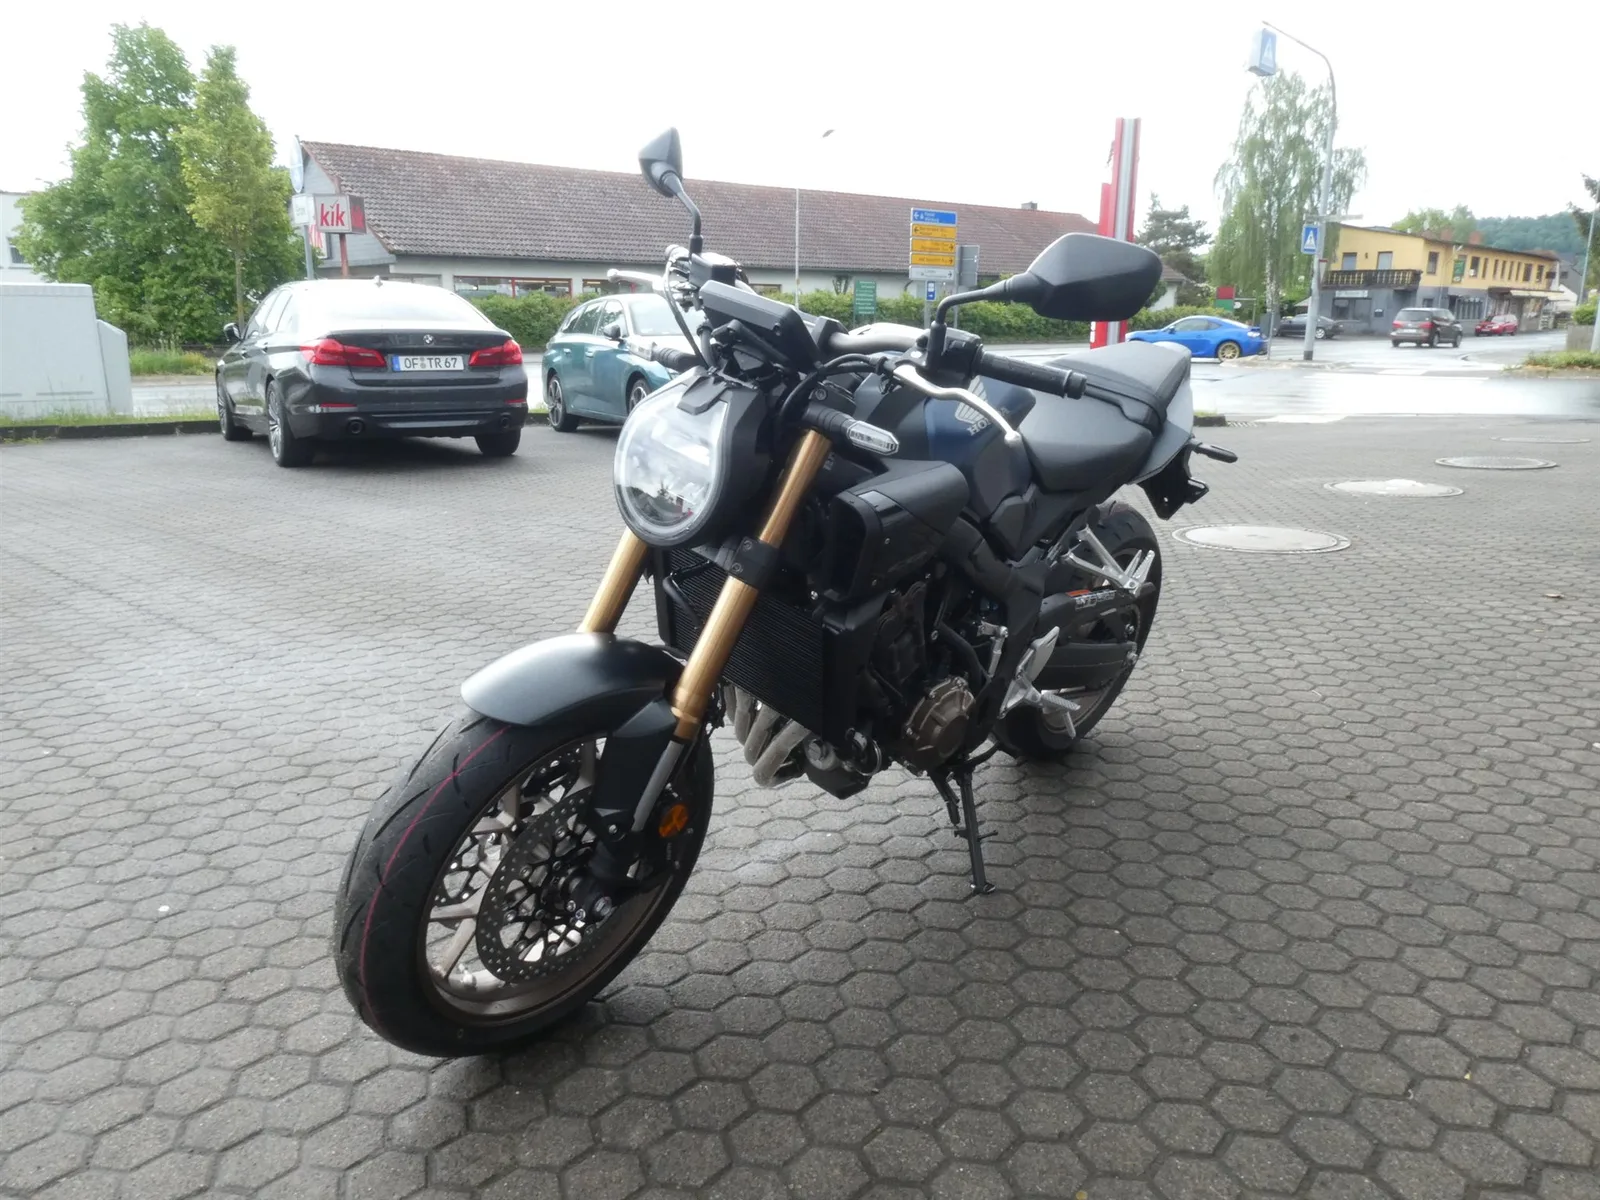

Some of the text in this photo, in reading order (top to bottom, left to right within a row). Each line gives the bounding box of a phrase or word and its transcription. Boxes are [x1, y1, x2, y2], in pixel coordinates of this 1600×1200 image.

[404, 357, 458, 369] OF TR 67
